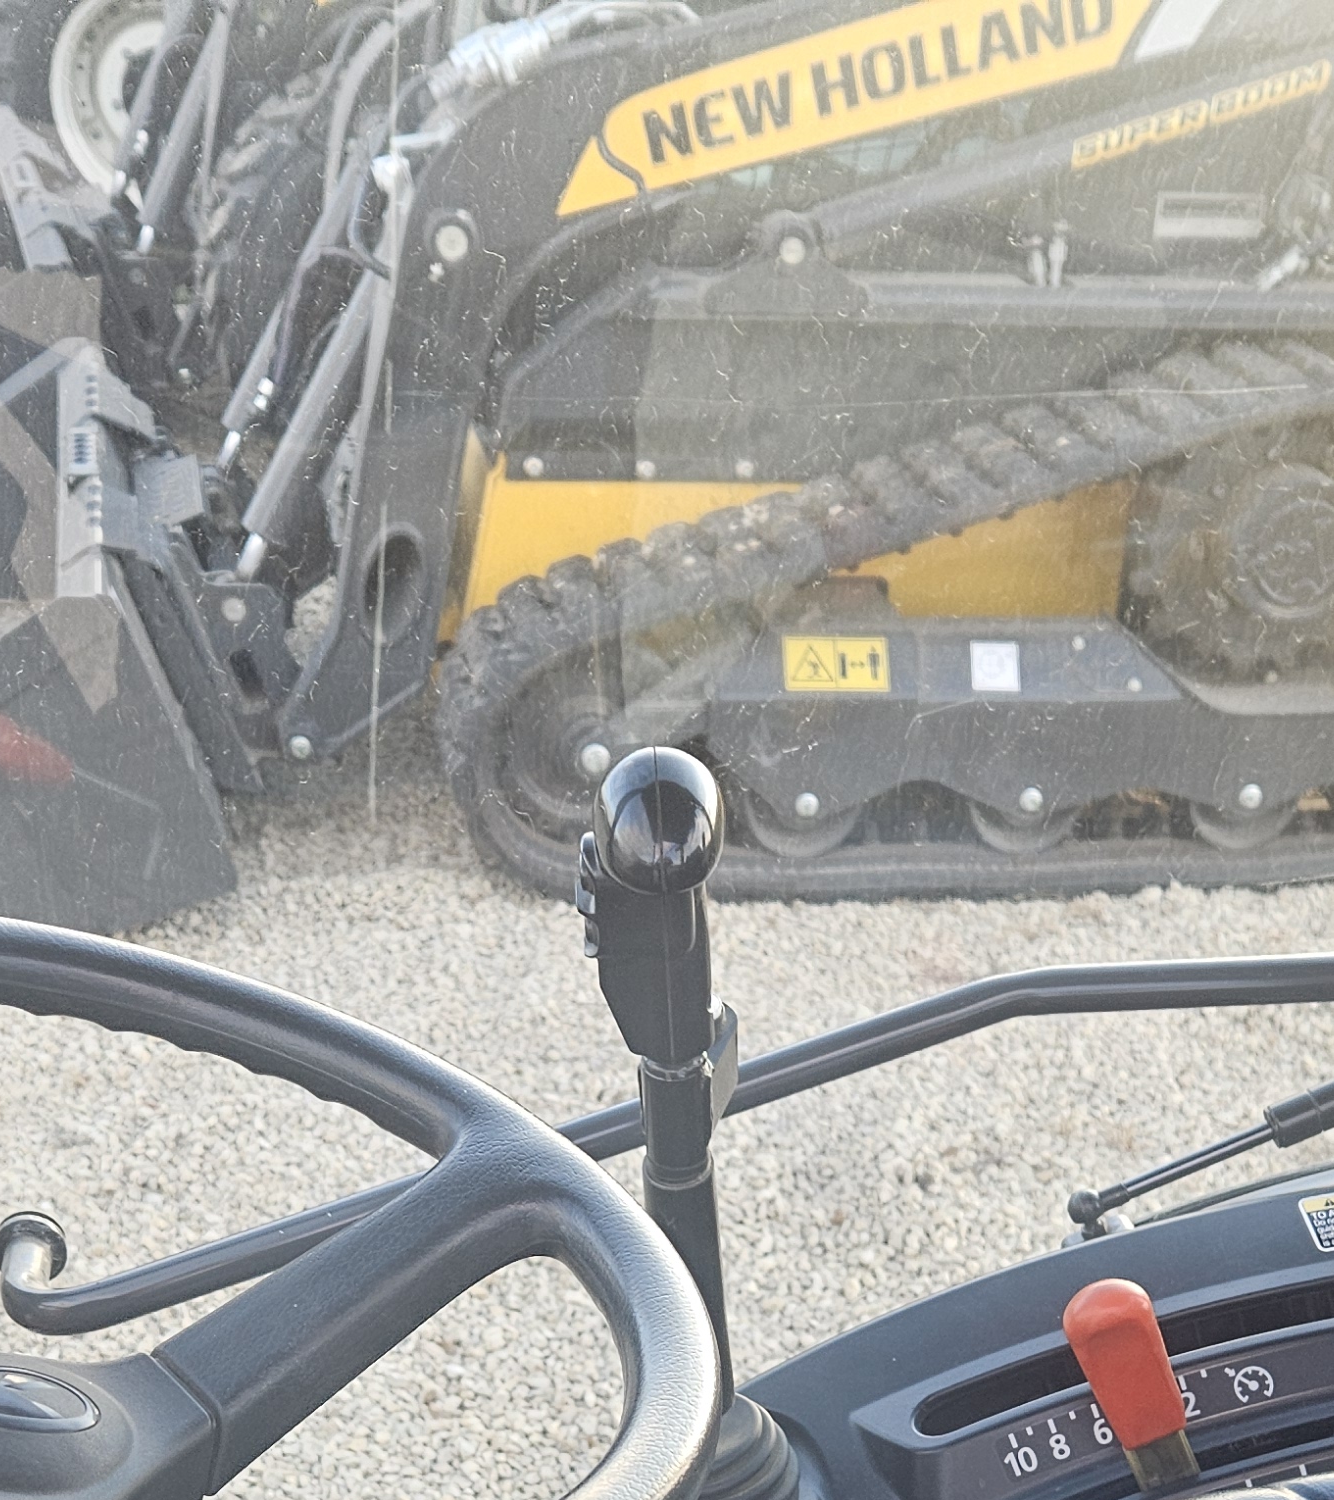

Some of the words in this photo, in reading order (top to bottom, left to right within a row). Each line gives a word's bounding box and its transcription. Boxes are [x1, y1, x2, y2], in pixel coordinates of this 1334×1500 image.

[641, 72, 794, 165] NEW
[810, 0, 1113, 118] HOLLAND
[1310, 1211, 1326, 1220] TO
[1003, 1446, 1038, 1477] 10
[1048, 1433, 1071, 1460] 8
[1093, 1418, 1113, 1445] 6
[1182, 1391, 1201, 1418] 2
